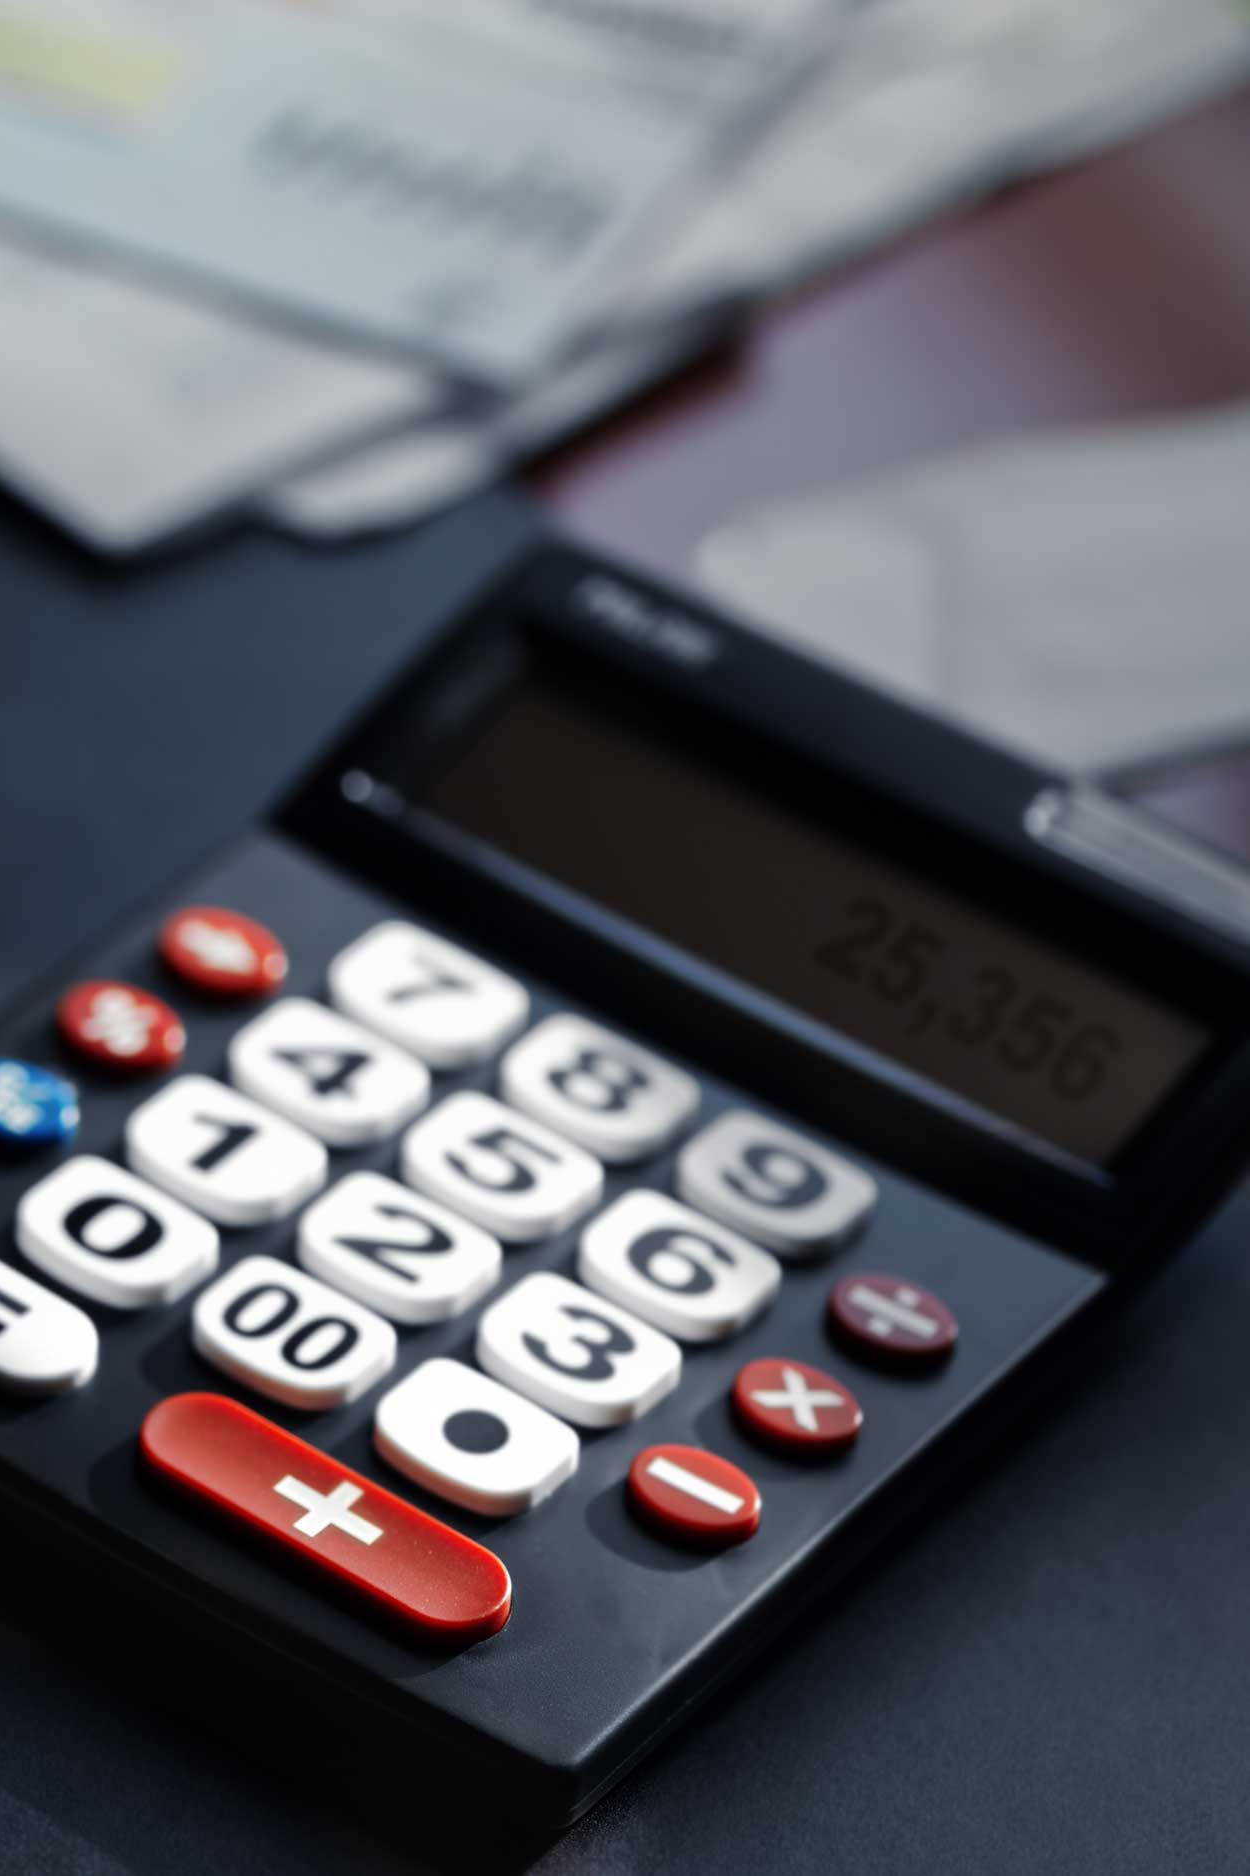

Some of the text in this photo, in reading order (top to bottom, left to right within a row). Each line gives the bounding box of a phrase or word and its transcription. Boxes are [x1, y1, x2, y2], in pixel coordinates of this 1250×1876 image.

[384, 946, 480, 1004] 7
[814, 896, 1122, 1102] 25,356
[270, 1045, 374, 1098] 4
[549, 1046, 648, 1113] 8
[192, 1109, 262, 1176] 1
[442, 1126, 566, 1195] 5
[720, 1142, 830, 1210] 9
[61, 1191, 165, 1261] 0
[330, 1203, 457, 1286] 2
[624, 1226, 738, 1299] 6
[223, 1281, 359, 1373] 00
[522, 1304, 637, 1382] 3
